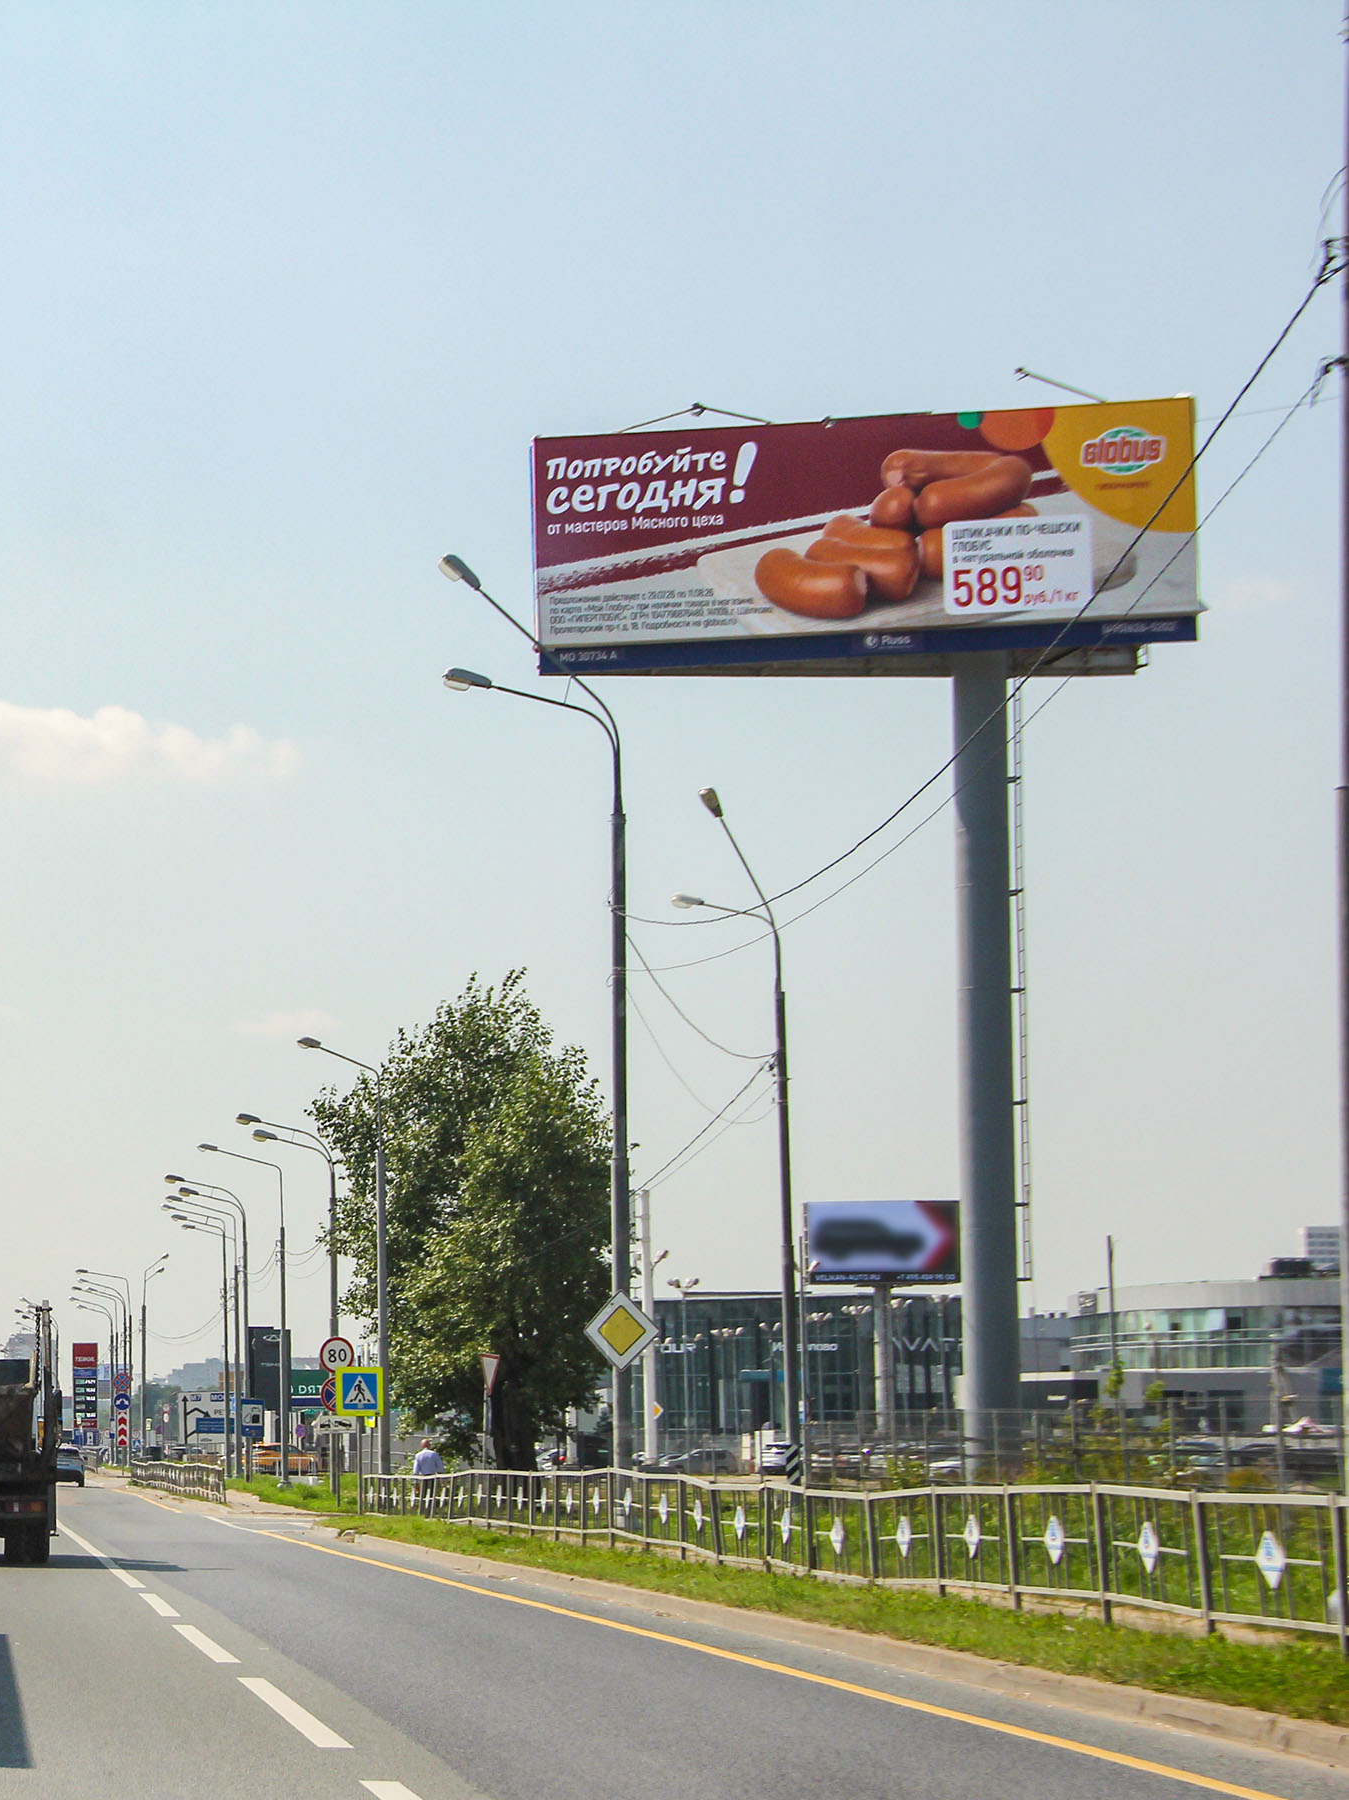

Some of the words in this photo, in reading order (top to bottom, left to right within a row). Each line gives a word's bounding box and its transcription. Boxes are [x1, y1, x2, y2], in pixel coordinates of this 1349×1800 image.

[546, 446, 727, 481] Попробуйте
[547, 523, 562, 536] от
[564, 519, 629, 535] мастеров
[631, 516, 689, 531] Мясного
[691, 514, 725, 529] цеха
[952, 525, 1012, 540] ШПИКАЧКИ
[1015, 521, 1081, 536] ПО-ЧЕШСКИ
[952, 540, 993, 553] ГЛОБУС
[962, 549, 1024, 564] натуральной
[1026, 548, 1075, 560] оболочке
[952, 566, 1023, 608] 589
[1023, 564, 1045, 582] 90
[1065, 591, 1080, 602] кг
[327, 1348, 348, 1363] 80
